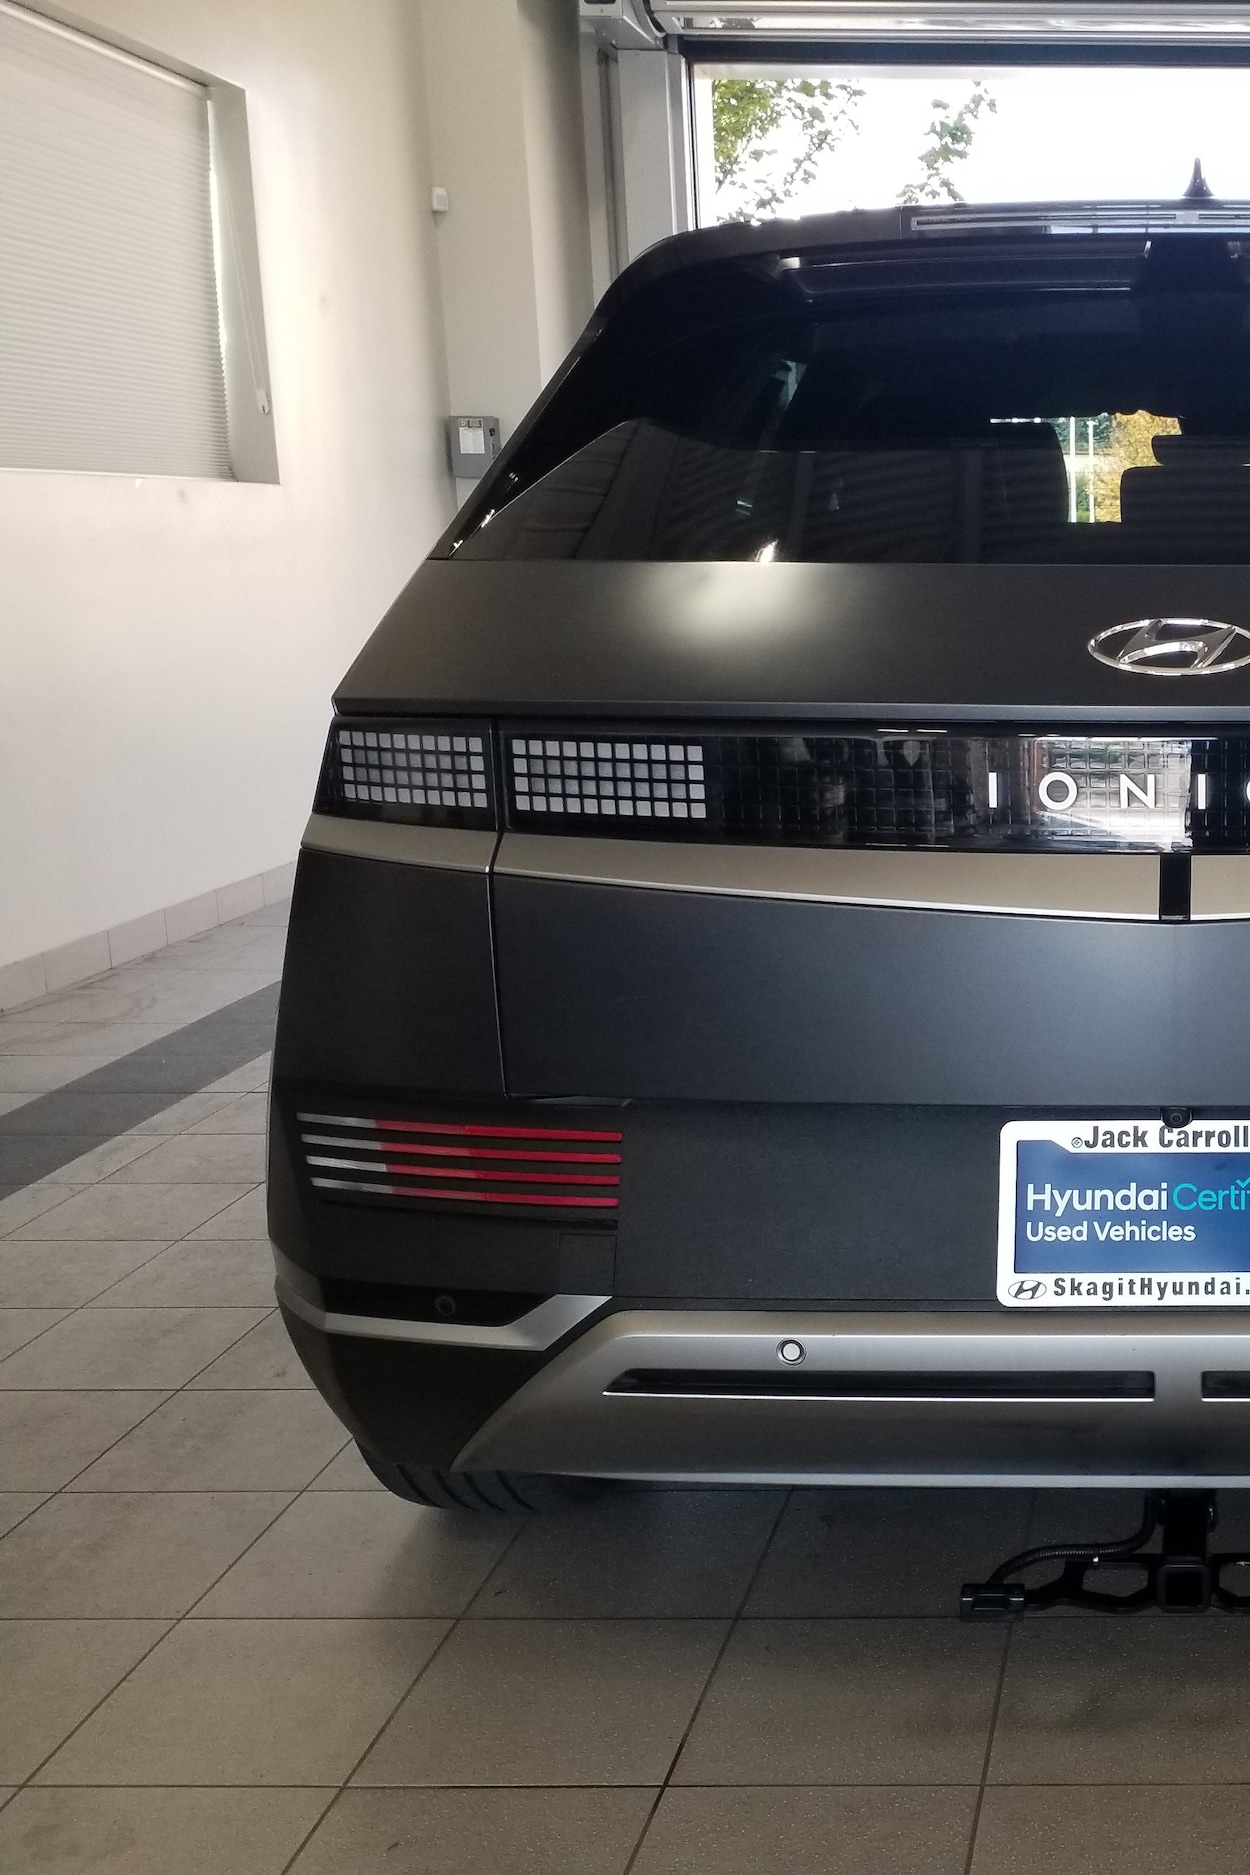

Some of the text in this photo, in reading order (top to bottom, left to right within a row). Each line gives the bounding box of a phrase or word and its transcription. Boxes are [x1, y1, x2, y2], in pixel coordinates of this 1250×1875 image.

[1084, 1125, 1149, 1148] Jack
[1026, 1182, 1168, 1217] Hyundai
[1026, 1220, 1197, 1242] Used Vehicles
